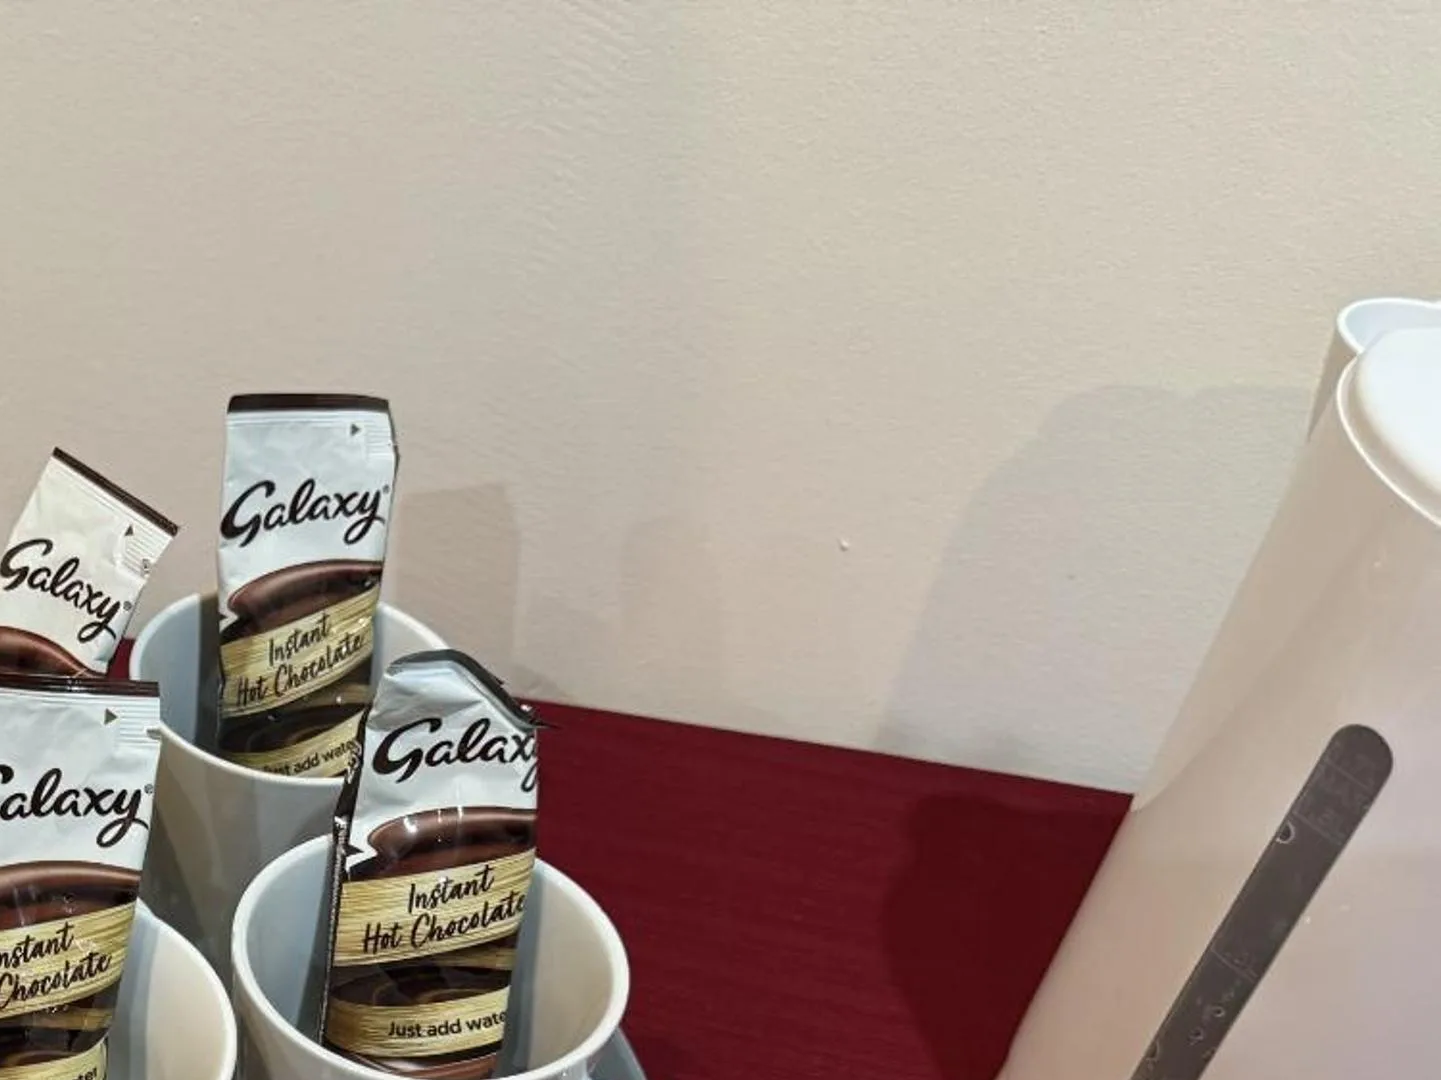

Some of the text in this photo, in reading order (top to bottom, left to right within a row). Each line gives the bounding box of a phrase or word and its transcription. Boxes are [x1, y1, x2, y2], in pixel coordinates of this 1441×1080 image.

[220, 477, 386, 546] Galaxy
[268, 612, 331, 667] Instant
[236, 631, 364, 707] Hot Chocolate
[293, 754, 319, 774] add
[319, 739, 359, 763] wate
[407, 864, 495, 914] Instant
[362, 890, 526, 954] Hot Chocolate
[387, 1011, 507, 1038] Just add wate
